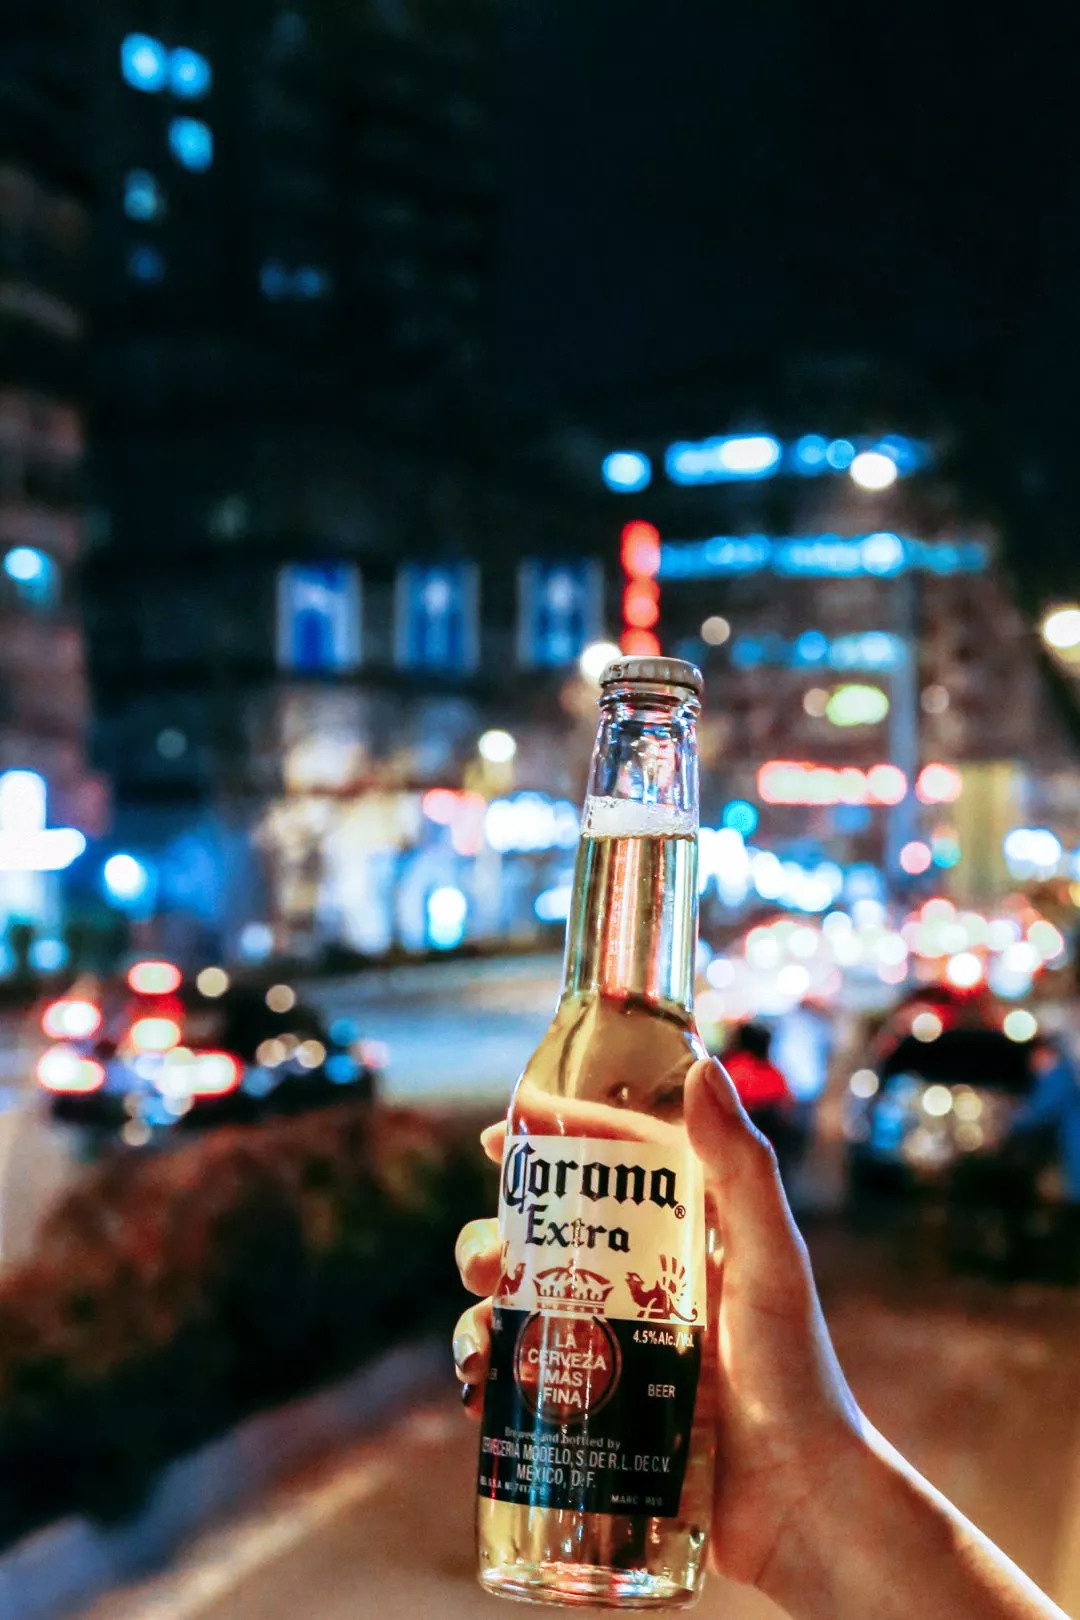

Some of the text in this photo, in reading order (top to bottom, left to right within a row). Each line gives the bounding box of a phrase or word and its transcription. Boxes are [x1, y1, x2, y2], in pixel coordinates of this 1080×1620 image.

[503, 1141, 678, 1214] Corona
[525, 1204, 631, 1253] Extra
[554, 1331, 577, 1349] LA
[528, 1348, 607, 1371] CERVEZA
[543, 1387, 582, 1408] FINA
[648, 1384, 676, 1398] BEER
[607, 1438, 621, 1451] by
